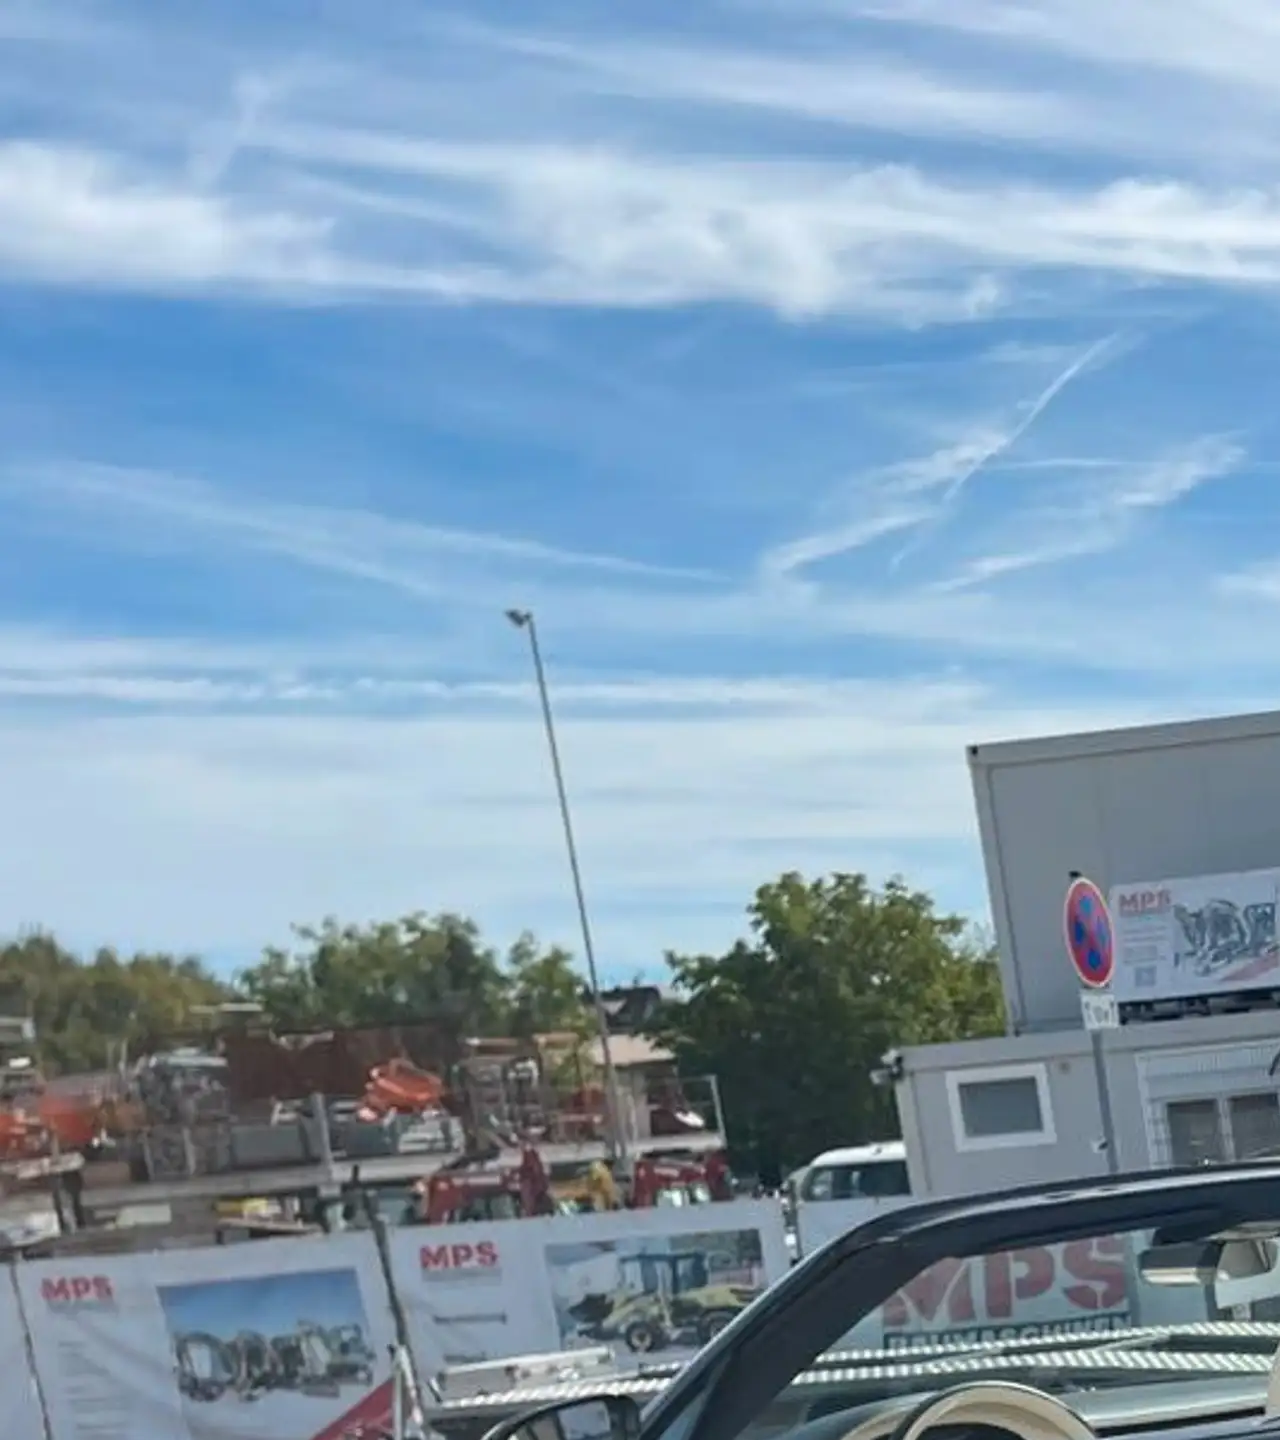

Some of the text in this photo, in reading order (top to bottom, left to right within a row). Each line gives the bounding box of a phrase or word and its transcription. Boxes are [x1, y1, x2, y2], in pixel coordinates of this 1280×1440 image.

[419, 1241, 499, 1269] MPS
[40, 1275, 114, 1304] MPS
[883, 1235, 1134, 1328] MPS
